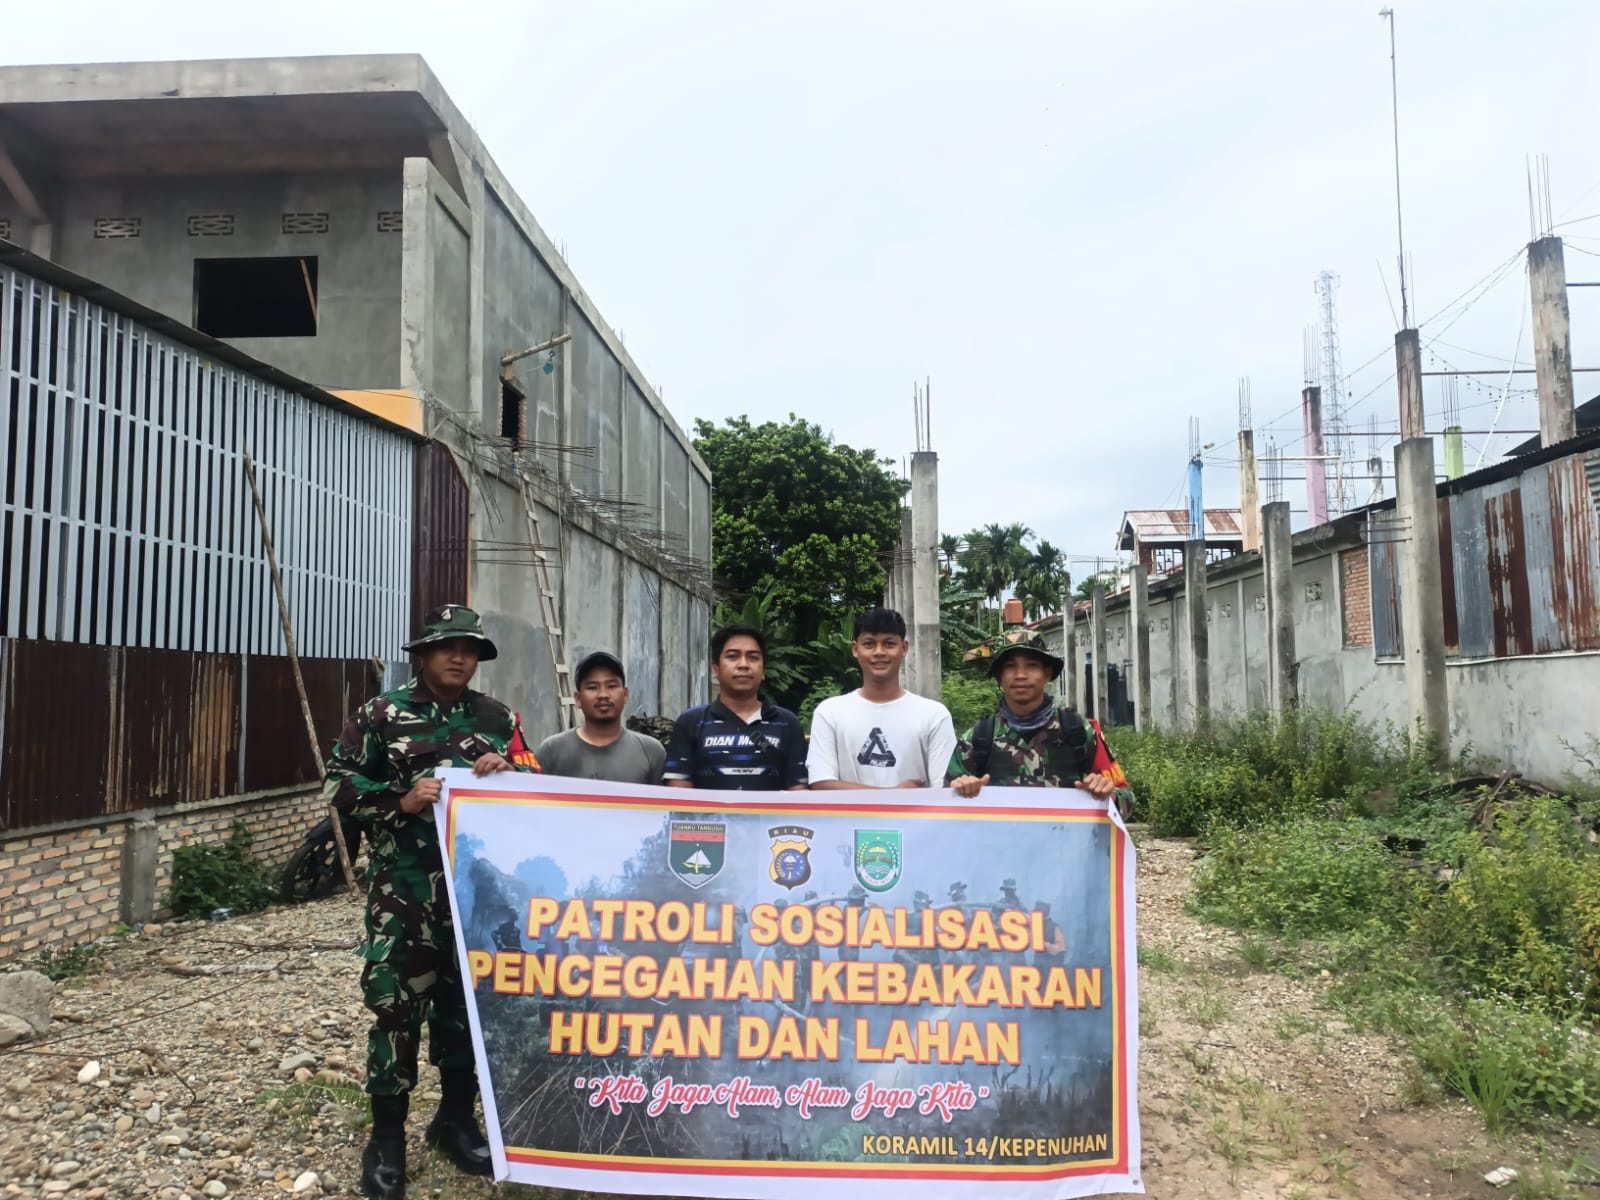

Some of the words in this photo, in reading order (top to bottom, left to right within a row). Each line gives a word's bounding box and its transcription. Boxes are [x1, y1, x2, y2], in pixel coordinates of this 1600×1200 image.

[704, 735, 735, 747] DIAN
[772, 828, 810, 837] RIAU
[527, 896, 735, 944] PATROLI
[749, 903, 1046, 952] SOSIALISASI
[467, 949, 796, 1002] PENCEGAHAN
[810, 959, 1103, 1010] KEBAKARAN
[549, 1011, 722, 1059] HUTAN
[737, 1015, 840, 1062] DAN
[855, 1017, 1021, 1066] LAHAN
[646, 1075, 712, 1118] Jaga
[714, 1075, 782, 1119] Alam,
[785, 1077, 849, 1120] Alam
[850, 1080, 916, 1122] Jaga
[862, 1135, 958, 1156] KORAMIL
[963, 1133, 1108, 1160] 14/KEPENUHAN
